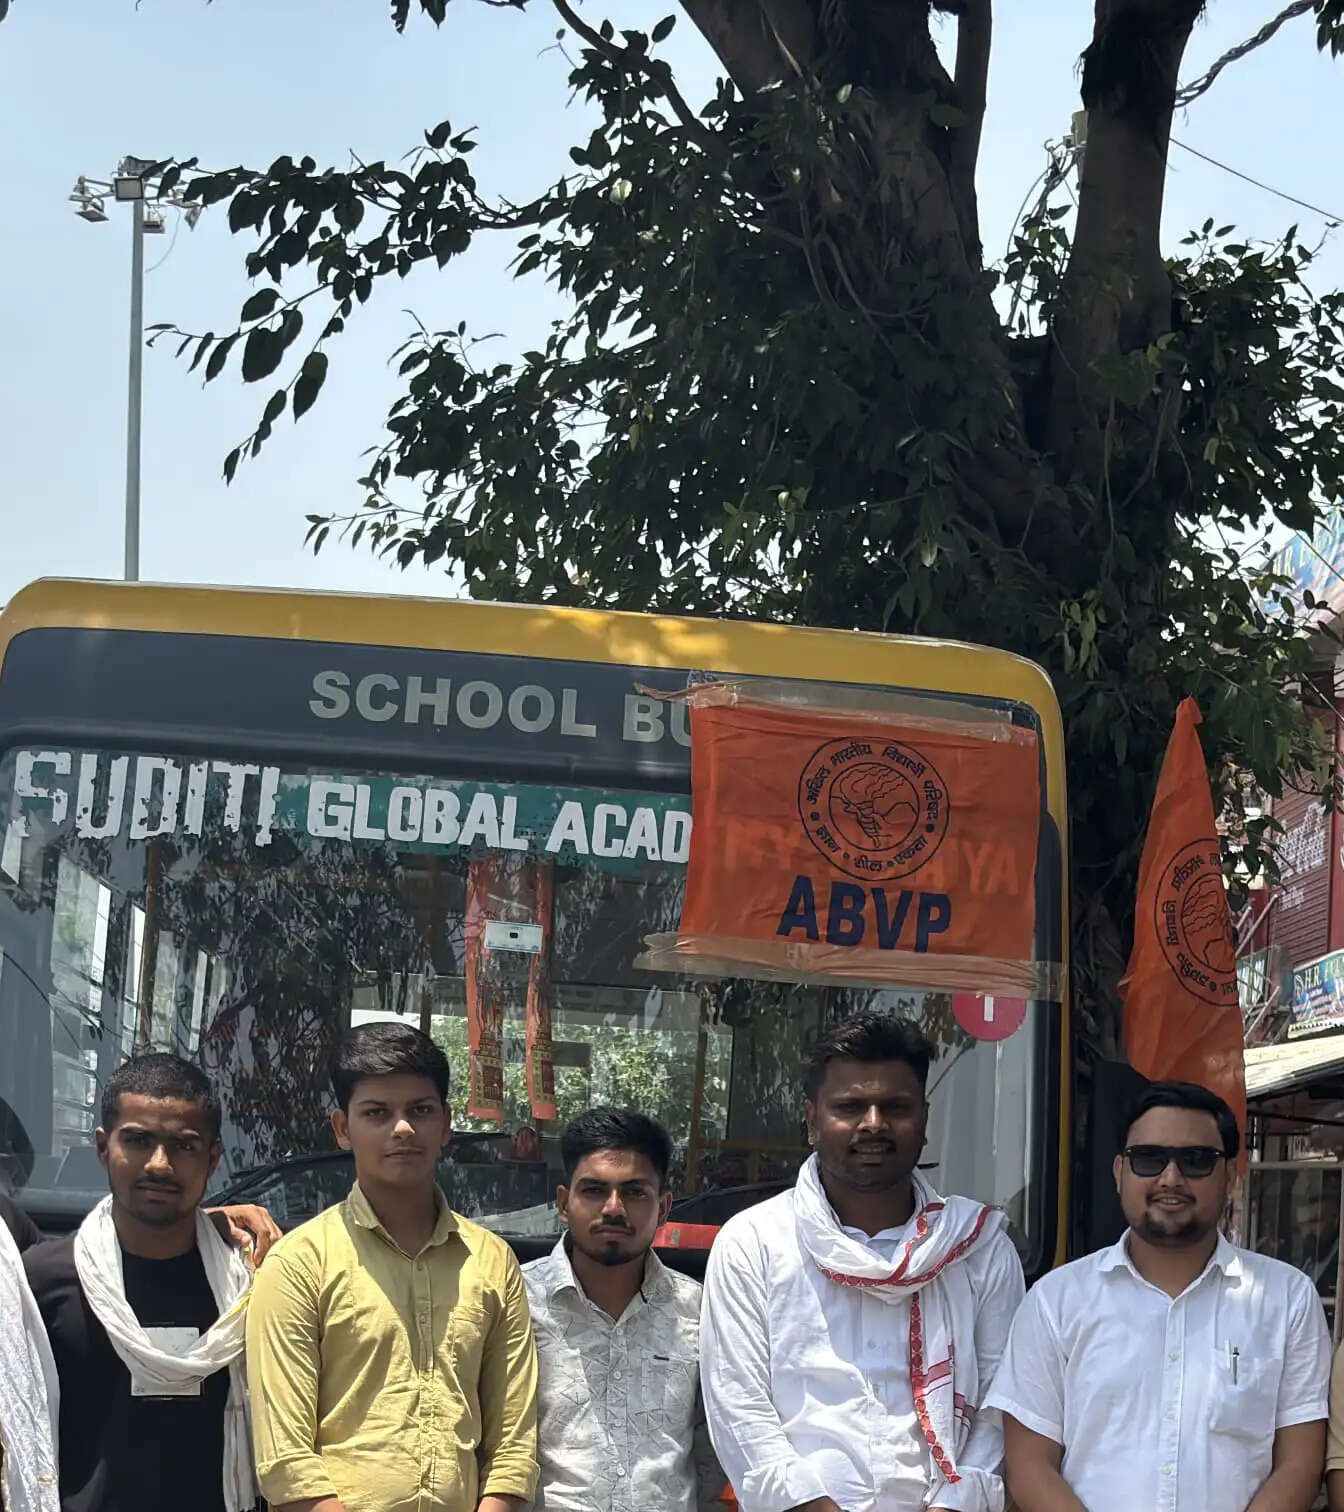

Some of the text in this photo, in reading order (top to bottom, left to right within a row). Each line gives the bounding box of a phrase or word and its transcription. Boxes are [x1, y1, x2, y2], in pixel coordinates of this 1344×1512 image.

[309, 671, 596, 738] SCHOOL
[14, 751, 280, 848] SUDITI
[307, 780, 528, 850] GLOBAL
[545, 800, 692, 864] ACAD
[776, 874, 952, 953] ABVP
